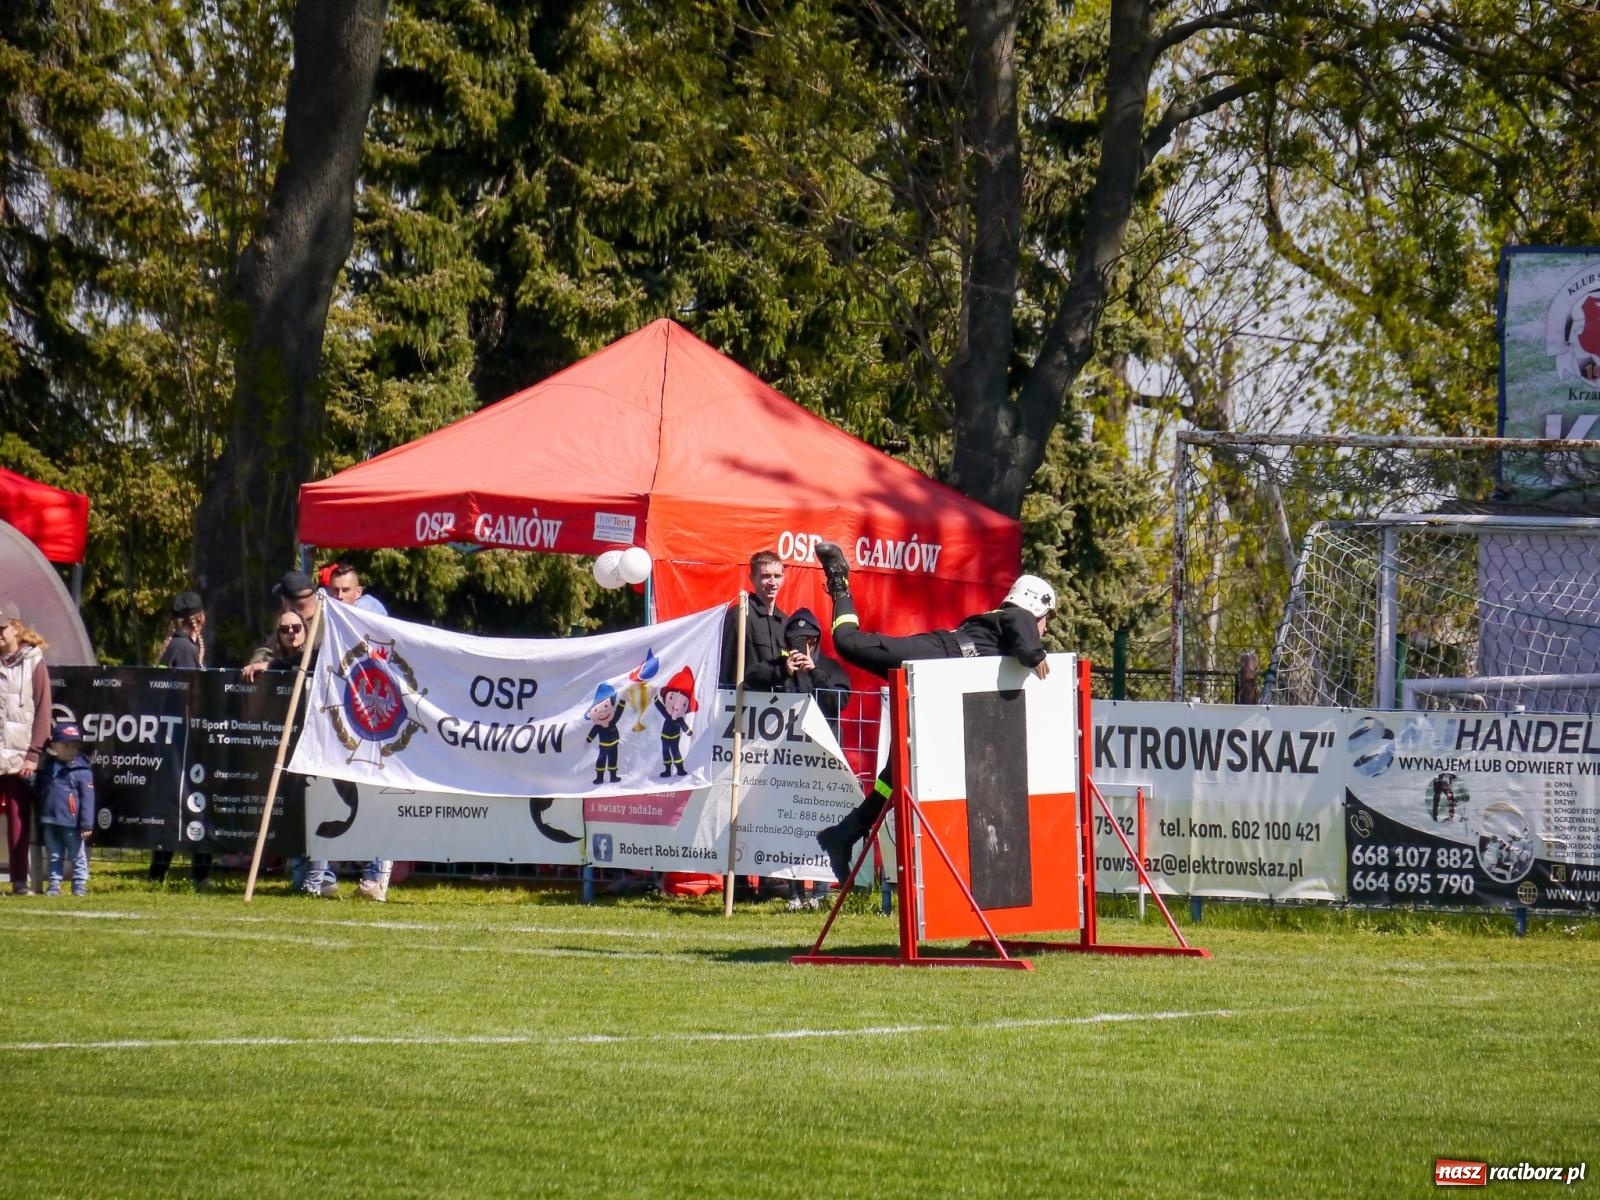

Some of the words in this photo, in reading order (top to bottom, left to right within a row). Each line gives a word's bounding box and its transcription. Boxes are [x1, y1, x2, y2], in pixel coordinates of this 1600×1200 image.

[1567, 274, 1596, 296] KLUB
[415, 512, 456, 542] OSP
[855, 533, 942, 573] GAMÓW
[469, 675, 538, 710] OSP
[82, 713, 183, 745] SPORT
[202, 719, 229, 731] Sport
[722, 695, 812, 743] ZIÓŁ
[208, 734, 215, 744] &
[437, 716, 568, 754] GAMÓW
[772, 748, 849, 771] Niewier
[1095, 725, 1335, 774] KTROWSKAZ"
[112, 753, 163, 771] sportowy
[1398, 757, 1470, 772] WYNAJEM
[1475, 758, 1501, 773] LUB
[1505, 760, 1573, 775] ODWIERT
[113, 770, 147, 785] online
[770, 778, 810, 790] Opawska
[826, 782, 854, 794] 47-470
[398, 805, 432, 818] SKLEP
[435, 806, 489, 819] FIRMOWY
[598, 802, 626, 815] kwiaty
[628, 805, 663, 816] jadalne
[799, 811, 817, 821] 888
[820, 812, 835, 823] 661
[755, 824, 817, 838] robnie20@gm
[1160, 818, 1185, 837] tel.
[1189, 818, 1227, 839] kom.
[1232, 820, 1260, 840] 602
[1264, 821, 1290, 841] 100
[1296, 822, 1320, 841] 421
[619, 843, 653, 856] Robert
[655, 845, 679, 857] Robi
[681, 846, 717, 859] Ziółka
[754, 850, 828, 867] @robiziolk
[1352, 844, 1389, 866] 668
[1395, 846, 1431, 868] 107
[1436, 848, 1474, 869] 882
[1352, 871, 1390, 892] 664
[1395, 872, 1431, 894] 695
[1436, 873, 1475, 895] 790
